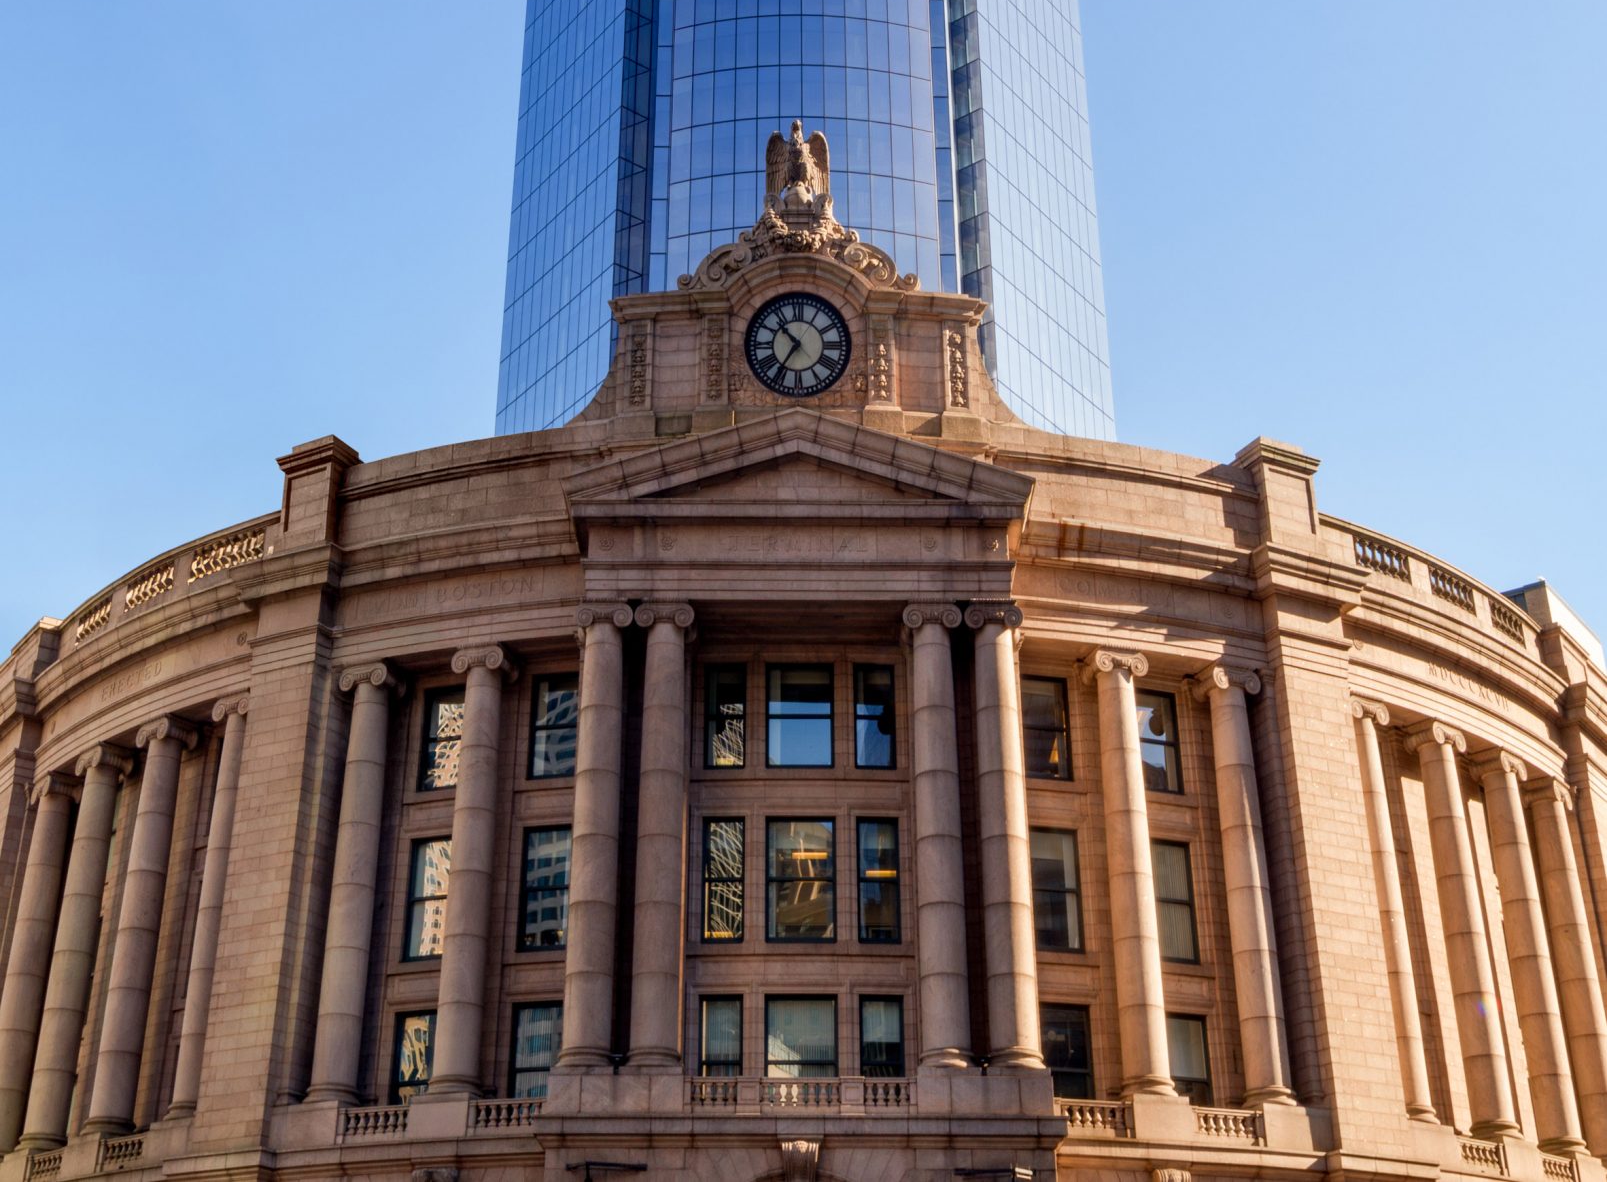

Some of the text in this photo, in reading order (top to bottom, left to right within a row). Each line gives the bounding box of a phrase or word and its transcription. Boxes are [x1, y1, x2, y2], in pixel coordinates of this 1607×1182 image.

[793, 304, 804, 322] XII
[761, 323, 776, 334] X
[820, 323, 837, 334] II
[755, 340, 773, 350] IX
[823, 341, 841, 350] III
[794, 370, 803, 389] VI
[811, 368, 822, 384] V
[436, 576, 534, 603] BOSTON
[101, 660, 162, 702] ERECTED
